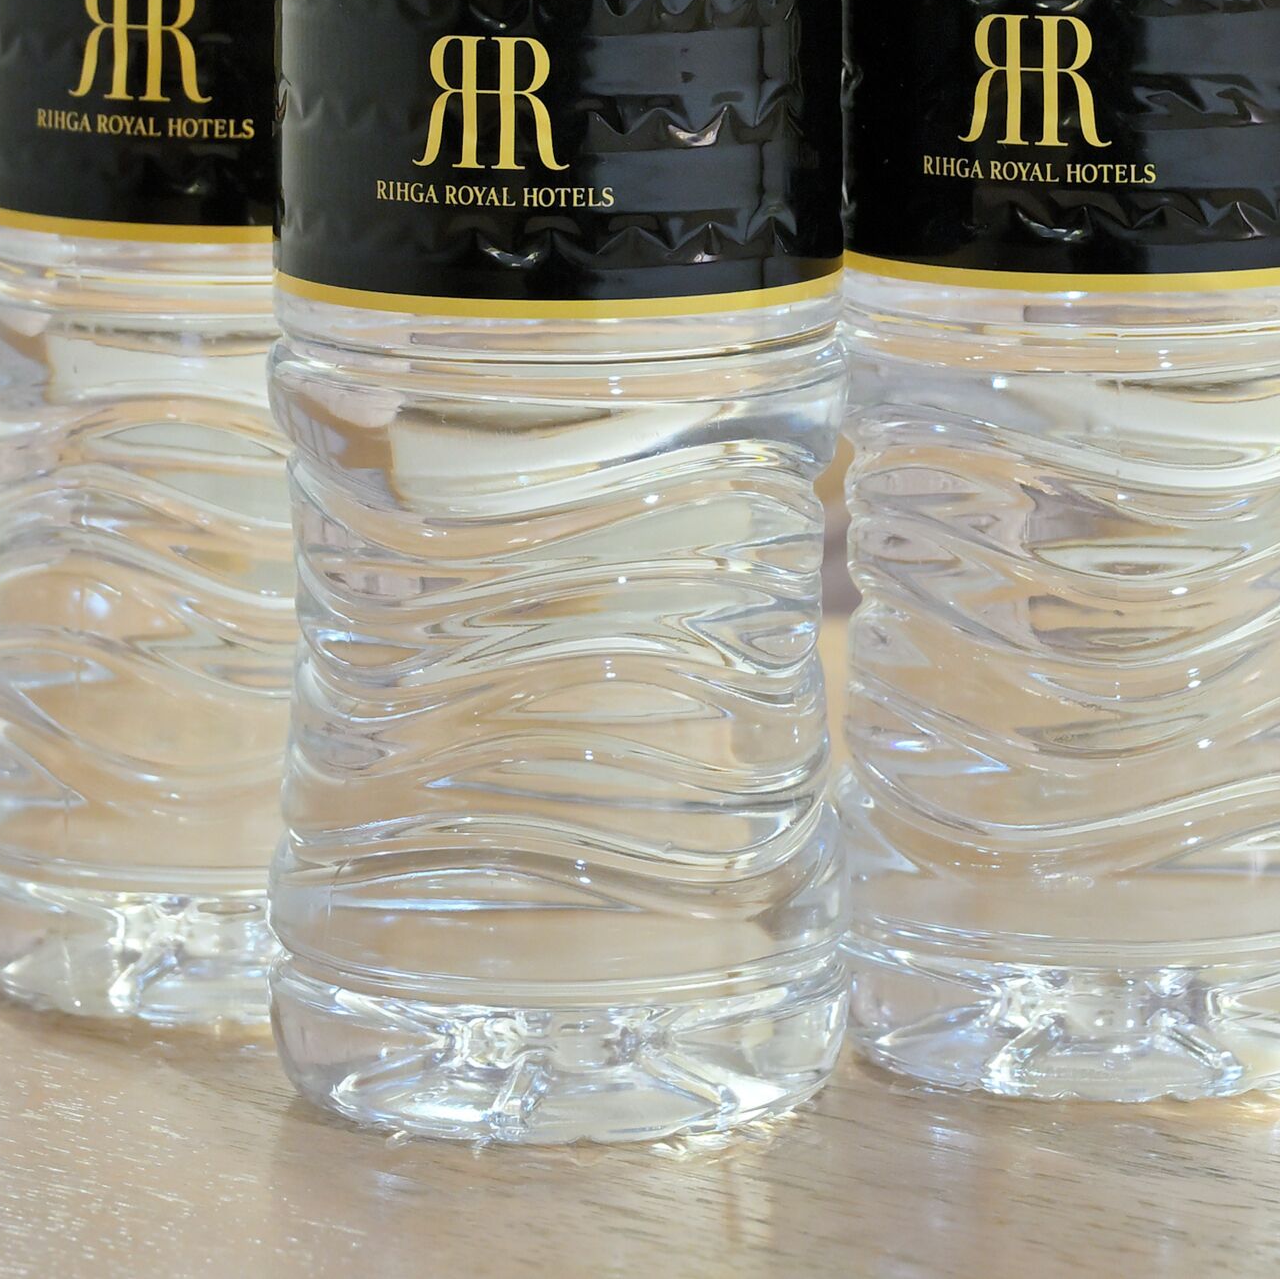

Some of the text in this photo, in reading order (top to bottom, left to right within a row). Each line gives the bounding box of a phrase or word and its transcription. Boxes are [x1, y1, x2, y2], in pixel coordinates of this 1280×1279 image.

[36, 108, 256, 140] RIHGA ROYAL HOTELS
[923, 155, 1157, 184] RIHGA ROYAL HOTELS
[376, 180, 615, 208] RIHGA ROYAL HOTELS
